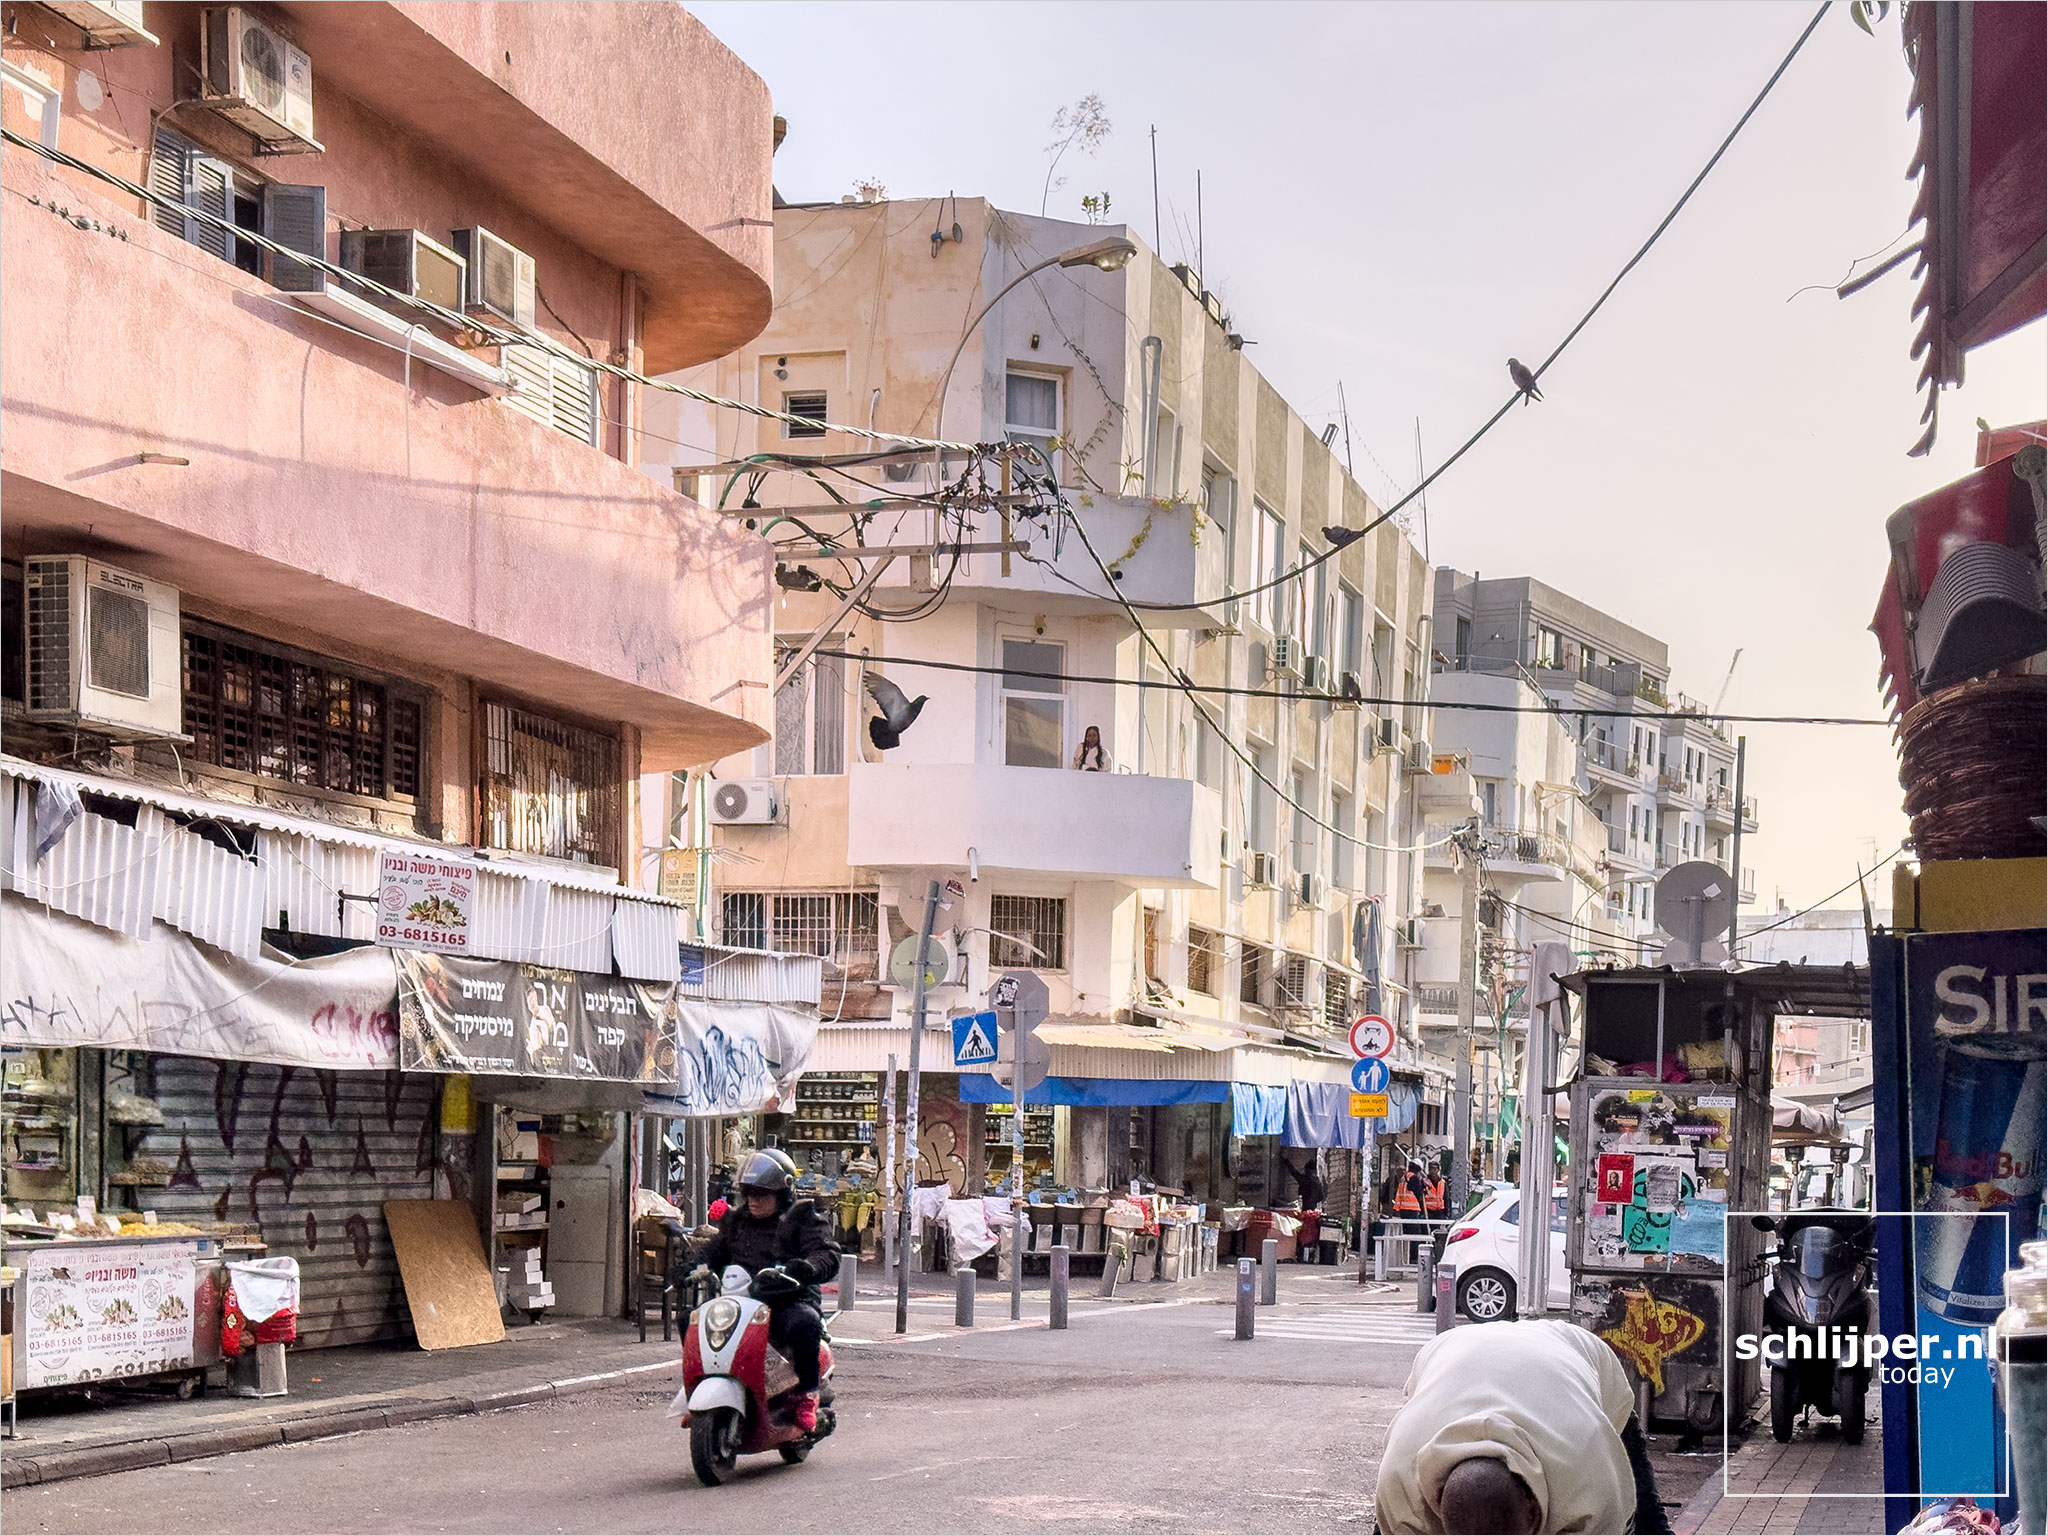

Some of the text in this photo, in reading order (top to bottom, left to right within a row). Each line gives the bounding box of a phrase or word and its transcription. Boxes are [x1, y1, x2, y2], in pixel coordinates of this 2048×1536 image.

[100, 570, 144, 593] ELECTRA
[384, 857, 473, 880] פיצוחי משה ובניו
[379, 925, 466, 946] 03-6815165
[461, 978, 506, 1002] צמחים
[585, 988, 637, 1016] תבלינים
[454, 1013, 514, 1042] מיסטיקה
[597, 1025, 626, 1052] קפה
[114, 1267, 137, 1281] משה
[29, 1337, 83, 1351] 03-6815165
[87, 1331, 137, 1344] 03-6815165
[143, 1326, 188, 1339] 03-6815165
